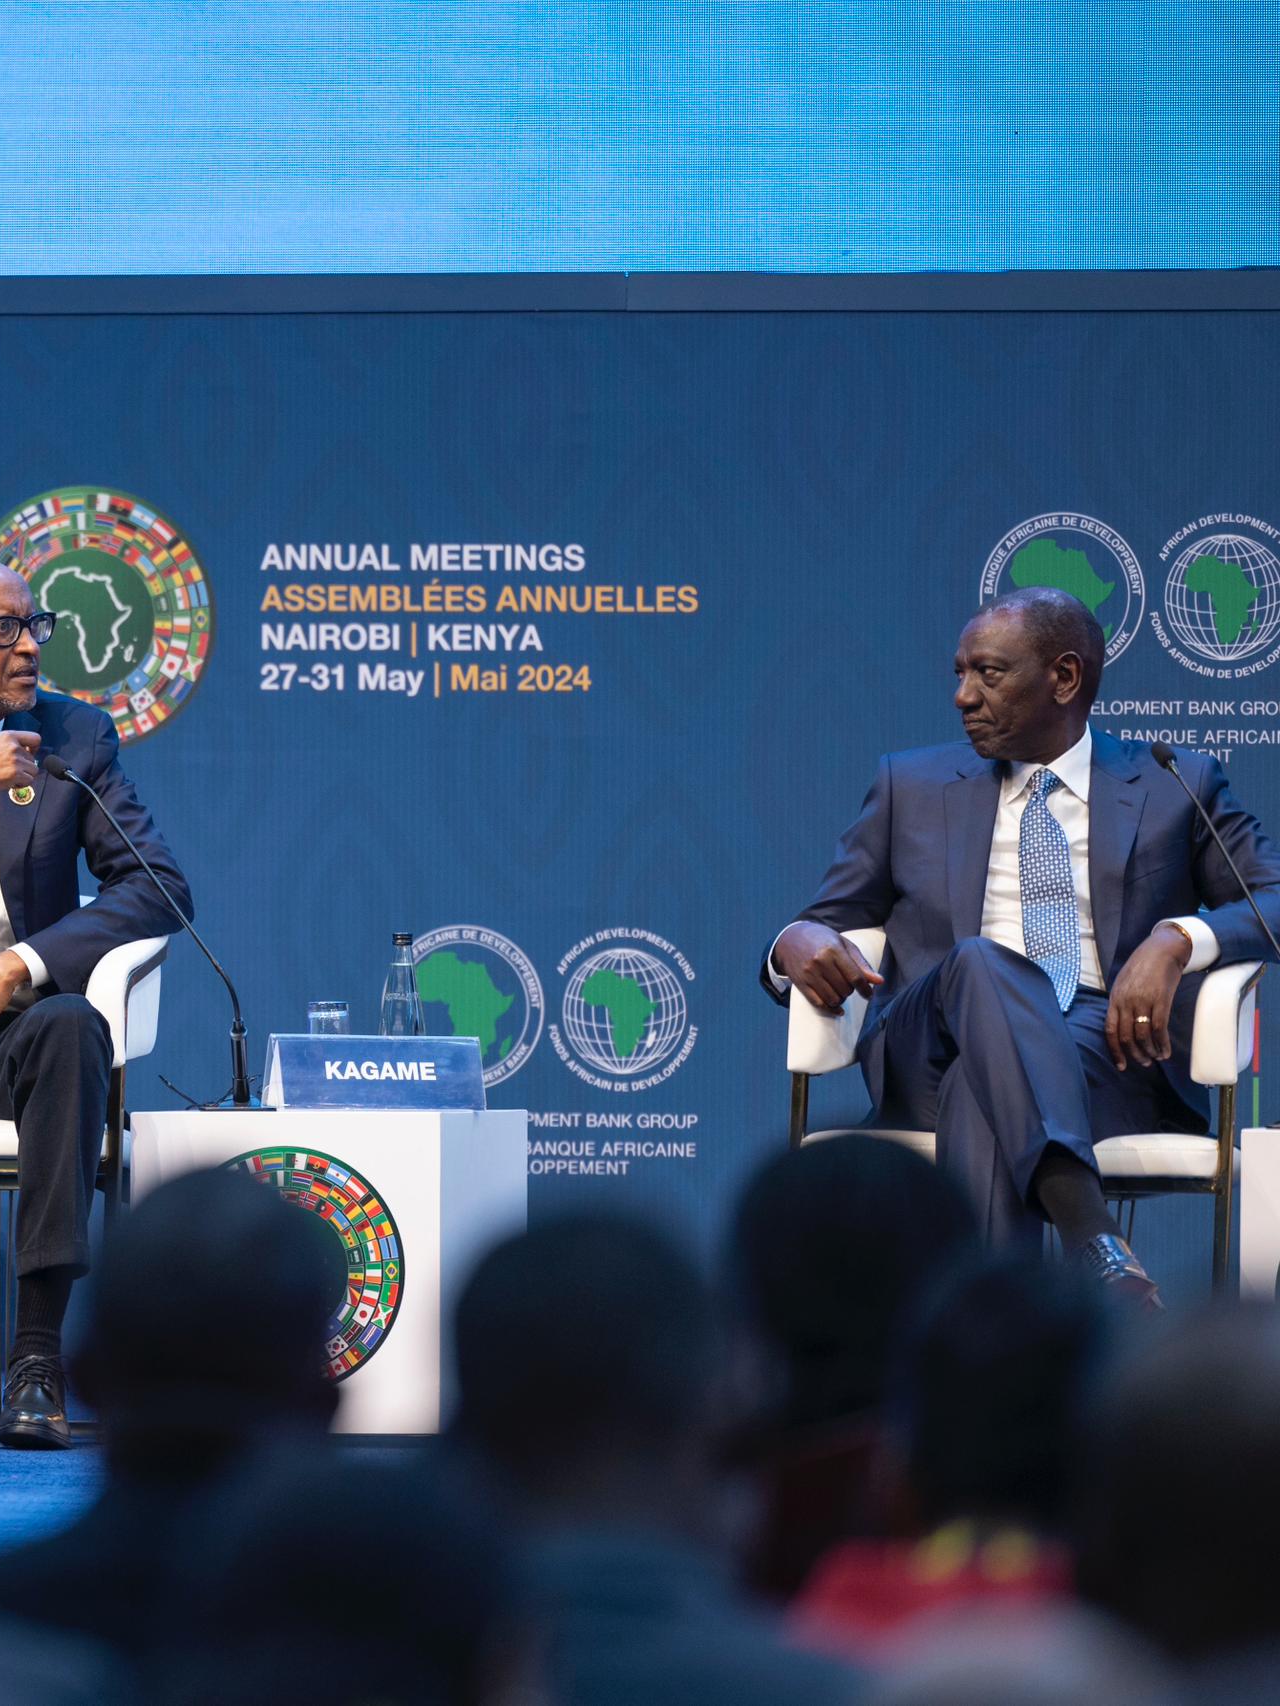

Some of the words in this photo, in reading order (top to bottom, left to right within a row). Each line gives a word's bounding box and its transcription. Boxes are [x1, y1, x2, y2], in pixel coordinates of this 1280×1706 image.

[1158, 521, 1198, 562] AFRICAN
[1198, 512, 1280, 539] DEVELOPMENT
[260, 543, 401, 571] ANNUAL
[410, 543, 586, 572] MEETINGS
[984, 548, 1008, 594] BANQUE
[1005, 516, 1059, 550] AFRICAINE
[1061, 516, 1078, 527] DE
[1079, 518, 1142, 596] DEVELOPPEMENT
[260, 578, 487, 613] ASSEMBLÉES
[495, 584, 700, 613] ANNUELLES
[261, 622, 401, 651] NAIROBI
[427, 624, 544, 651] KENYA
[1105, 630, 1131, 657] BANK
[1149, 611, 1171, 648] FONDS
[1168, 647, 1215, 678] AFRICAIN
[1216, 669, 1232, 679] DE
[1234, 644, 1280, 678] DEVELOP
[260, 662, 345, 691] 27-31
[357, 663, 425, 697] May
[450, 663, 508, 691] Mai
[517, 664, 592, 691] 2024
[1090, 700, 1184, 716] ELOPMENT
[1187, 700, 1236, 716] BANK
[1240, 700, 1280, 716] GRO
[1204, 730, 1280, 745] AFRICAI
[556, 935, 595, 976] AFRICAN
[595, 927, 676, 955] DEVELOPMENT
[673, 951, 696, 981] FUND
[412, 929, 460, 957] FRICAINE
[461, 929, 478, 941] DE
[479, 932, 541, 1009] DEVELOPPEMENT
[324, 1061, 437, 1081] KAGAME
[505, 1043, 530, 1070] BANK
[548, 1023, 570, 1062] FONDS
[566, 1059, 613, 1091] AFRICAIN
[613, 1081, 629, 1092] DE
[630, 1024, 699, 1092] DEVELOPPEMENT
[586, 1112, 633, 1128] BANK
[637, 1113, 698, 1129] GROUP
[601, 1141, 697, 1157] AFRICAINE
[529, 1160, 630, 1175] OPPEMENT
